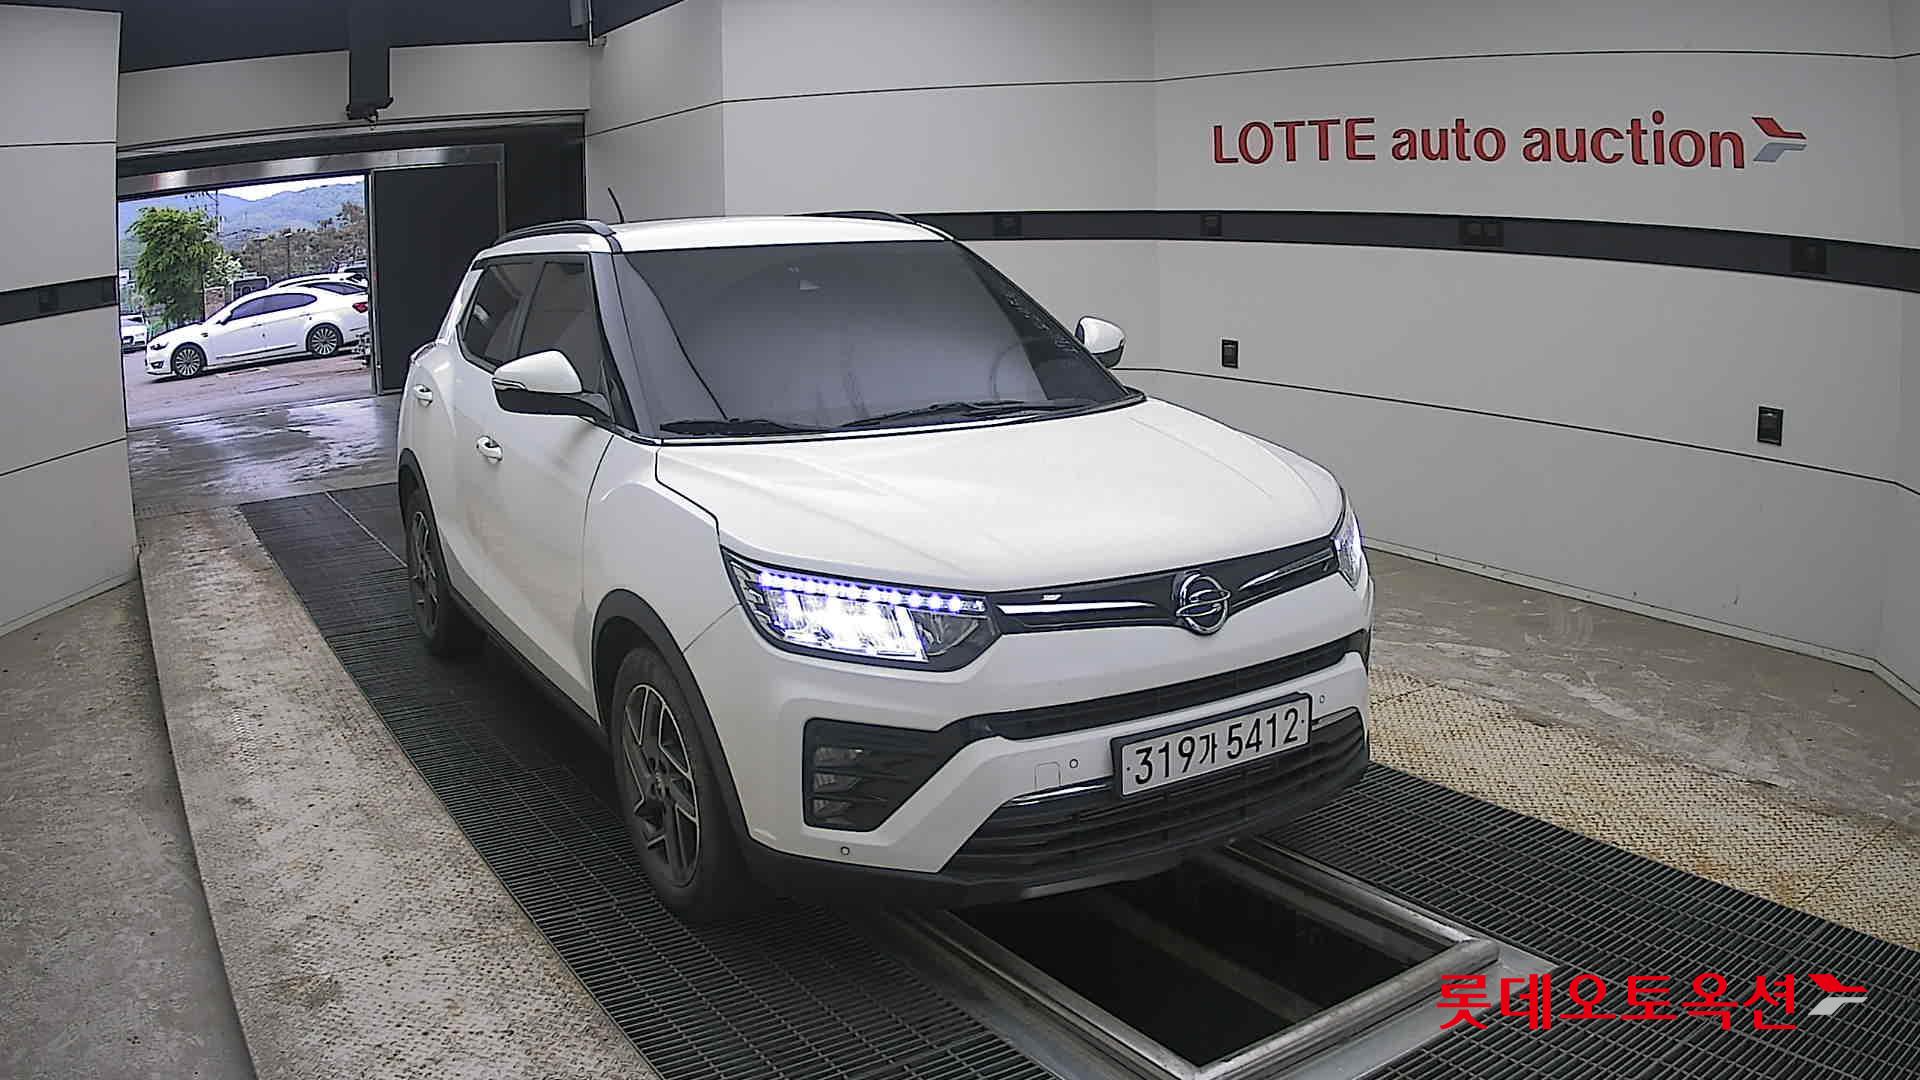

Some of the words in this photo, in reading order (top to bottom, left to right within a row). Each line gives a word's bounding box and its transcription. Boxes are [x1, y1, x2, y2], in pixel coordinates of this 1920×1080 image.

[1212, 116, 1377, 164] LOTTE
[1391, 118, 1507, 162] auto
[1521, 110, 1746, 170] auction
[1134, 732, 1218, 785] 319가
[1226, 707, 1299, 760] 5412
